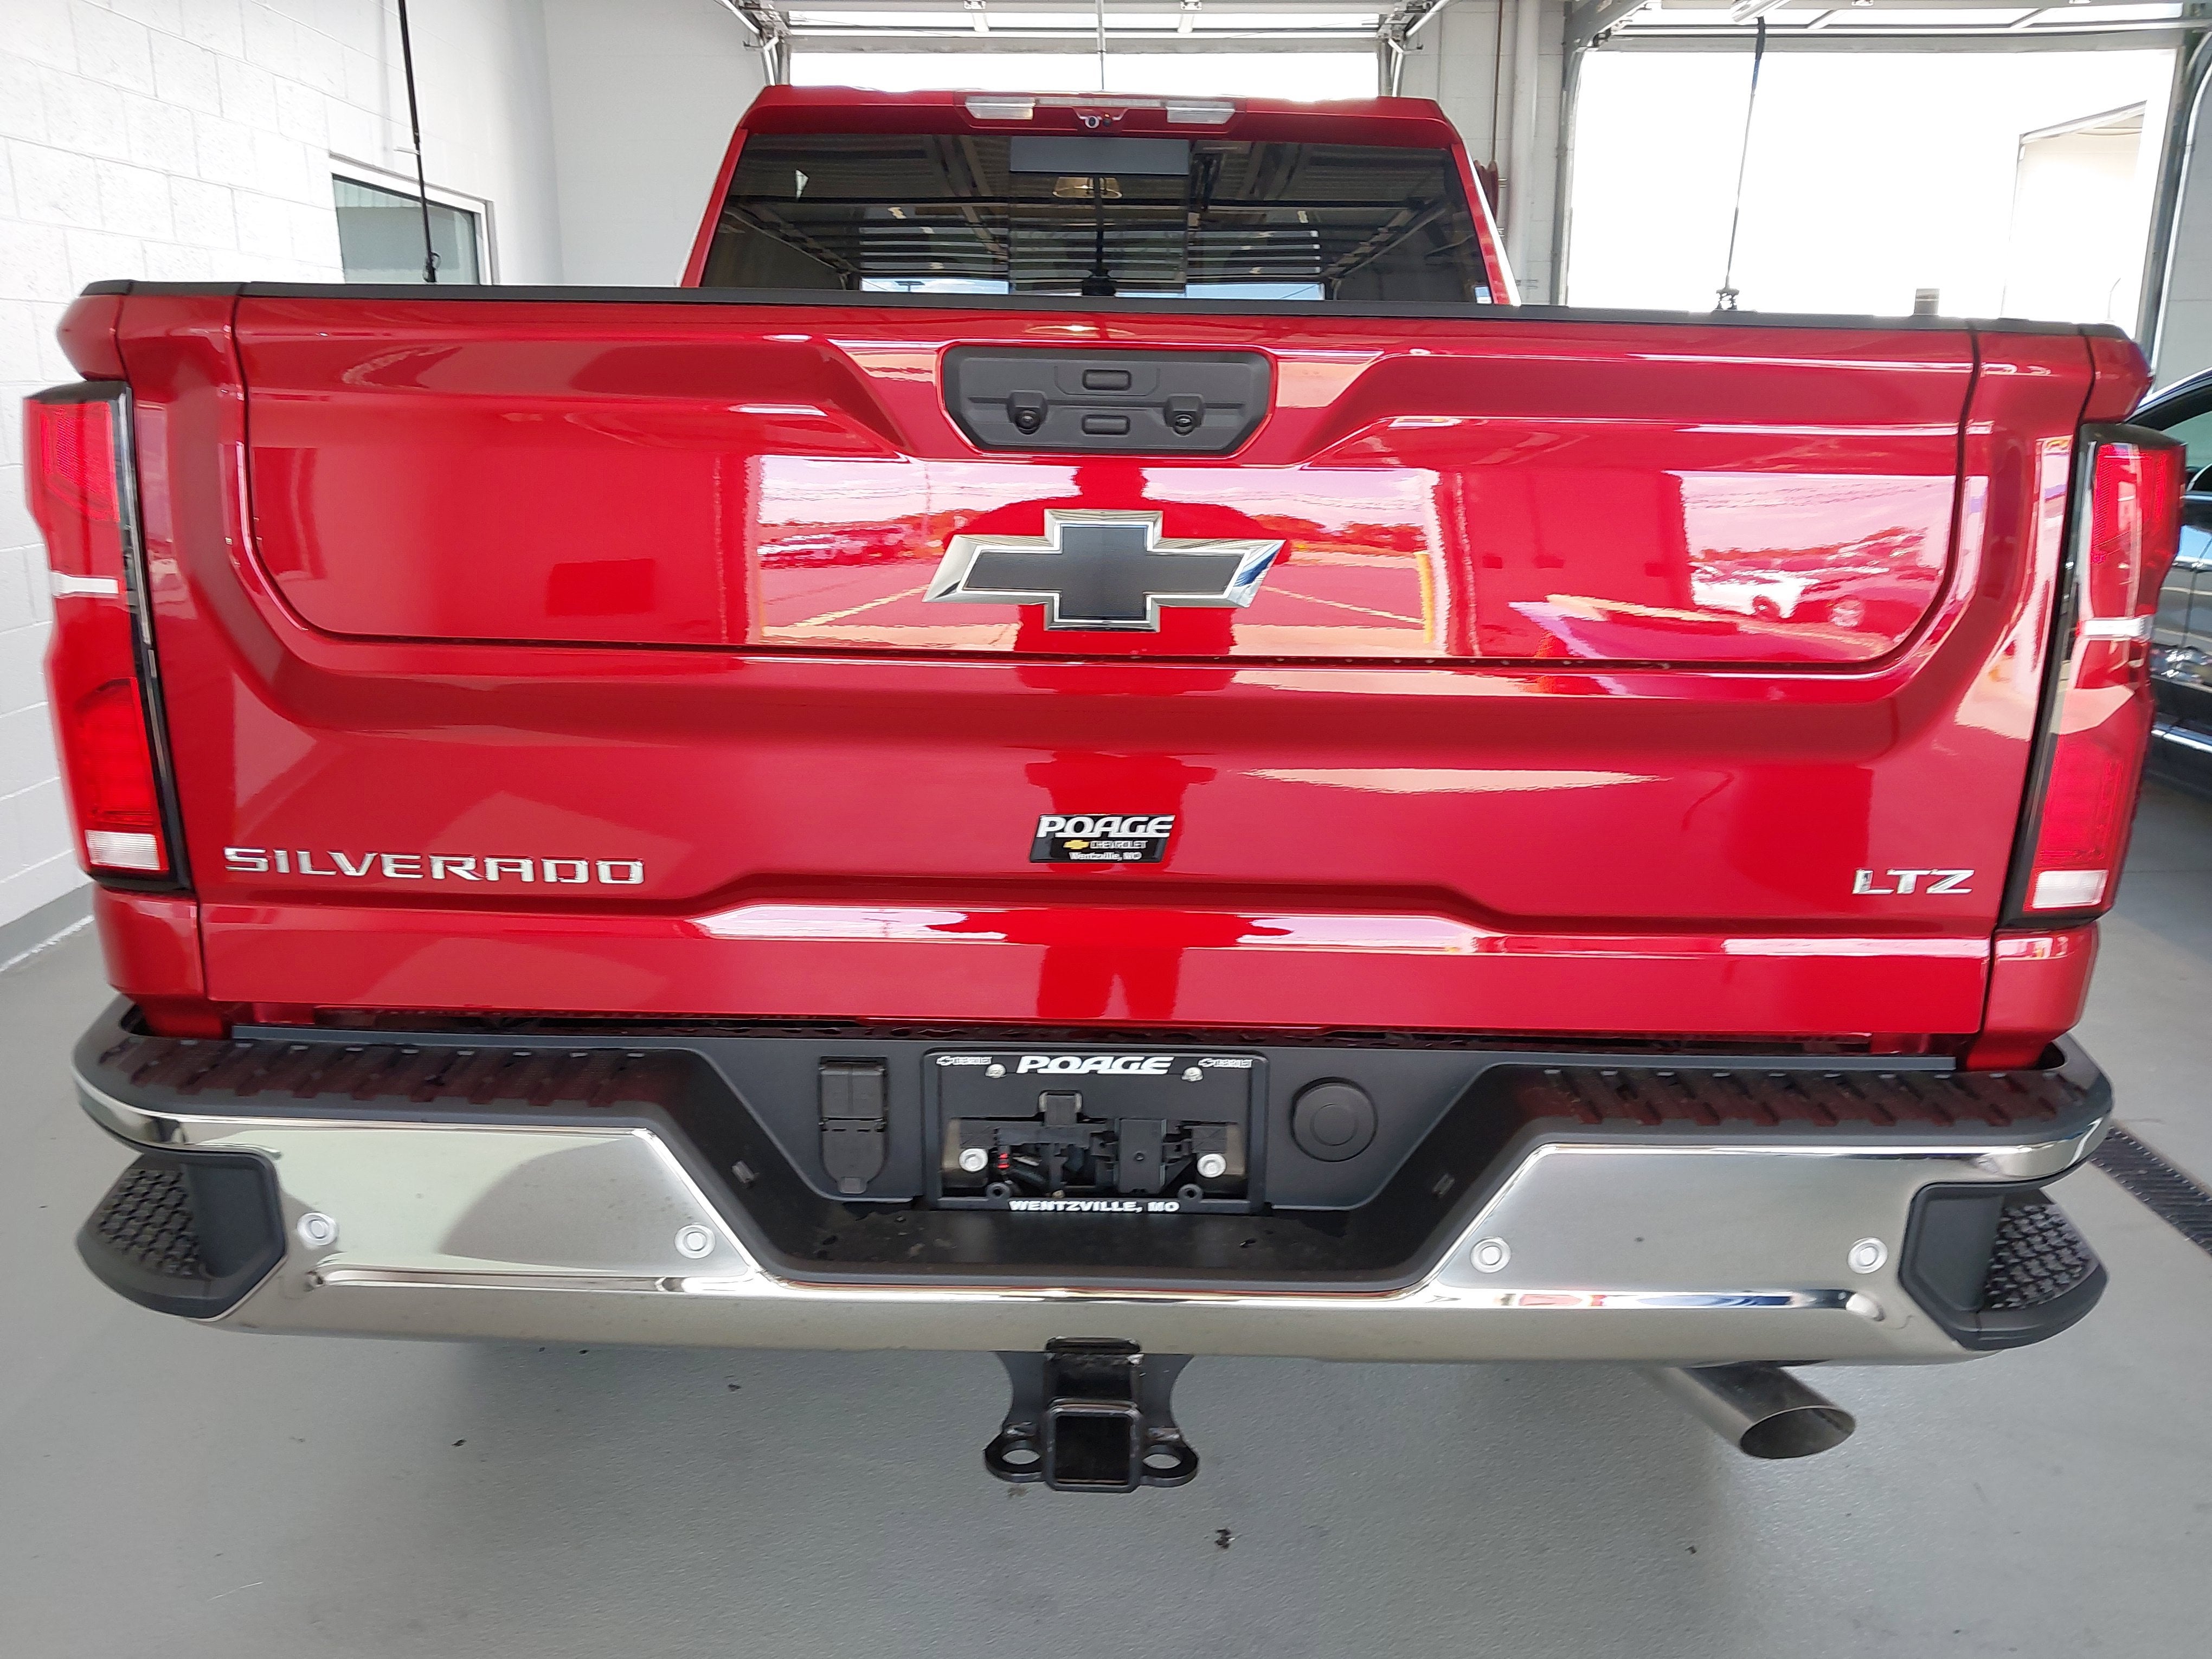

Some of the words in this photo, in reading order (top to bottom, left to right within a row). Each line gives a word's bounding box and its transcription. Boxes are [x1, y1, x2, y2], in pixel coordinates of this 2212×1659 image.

[1036, 816, 1175, 838] POAGE
[223, 846, 645, 884] SILVERADO
[1122, 852, 1142, 860] MO
[1852, 869, 1975, 895] LTZ
[1016, 1056, 1175, 1075] POAGE
[1009, 1200, 1143, 1213] WENTZVILLE,
[1147, 1201, 1180, 1212] MO
